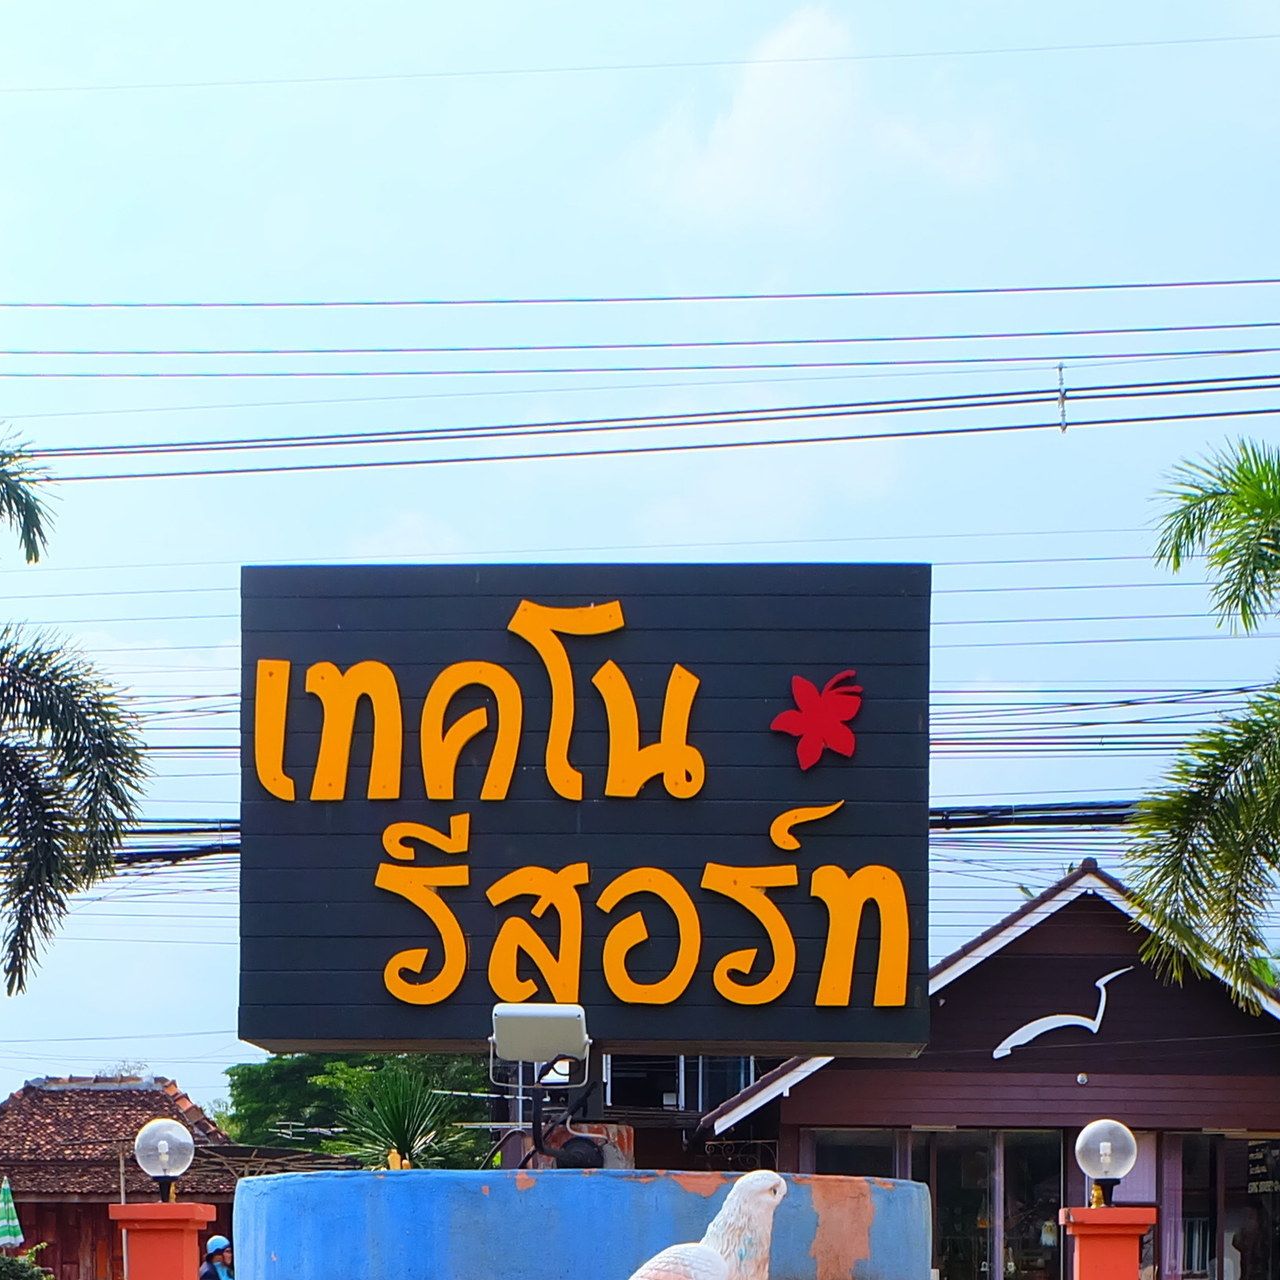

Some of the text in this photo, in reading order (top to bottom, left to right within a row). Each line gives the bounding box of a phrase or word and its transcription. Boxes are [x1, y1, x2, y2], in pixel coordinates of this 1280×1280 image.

[254, 599, 705, 802] เทคโน
[375, 799, 910, 1007] รีสอร์ท
